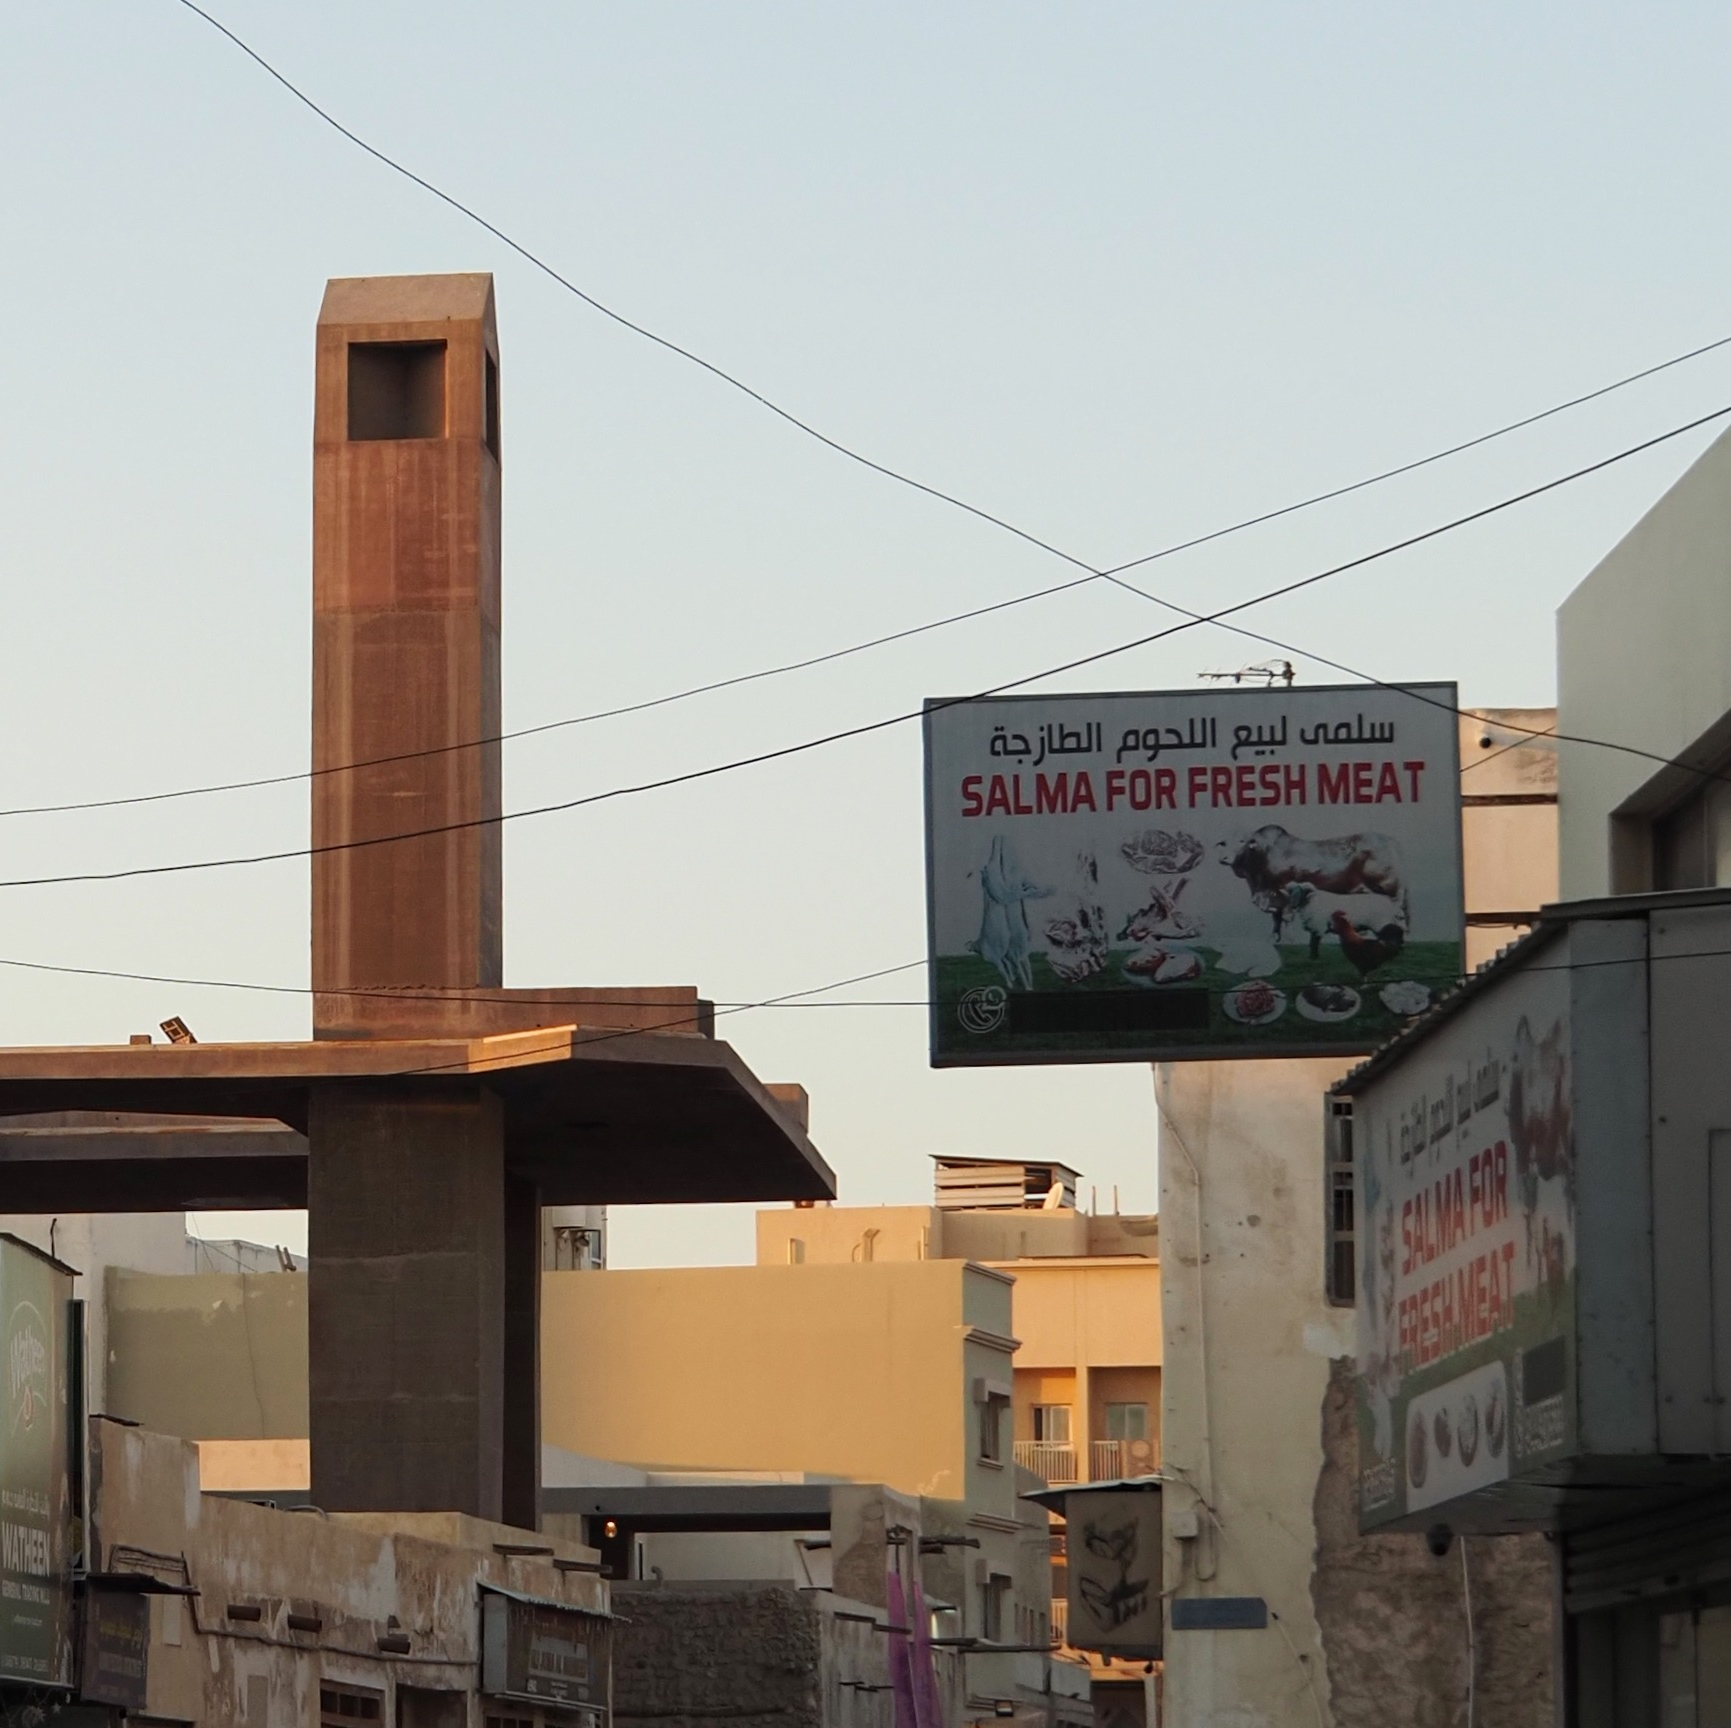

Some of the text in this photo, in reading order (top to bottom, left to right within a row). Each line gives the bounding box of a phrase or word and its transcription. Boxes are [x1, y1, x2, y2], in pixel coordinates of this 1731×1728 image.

[989, 714, 1395, 766] سلمى لبيع اللحوم الطازجة
[960, 760, 1425, 817] SALMA FOR FRESH MEAT
[1402, 1139, 1507, 1276] SALMA FOR
[1398, 1240, 1515, 1375] FRESH MEAT
[1, 1520, 51, 1577] WATHEEN
